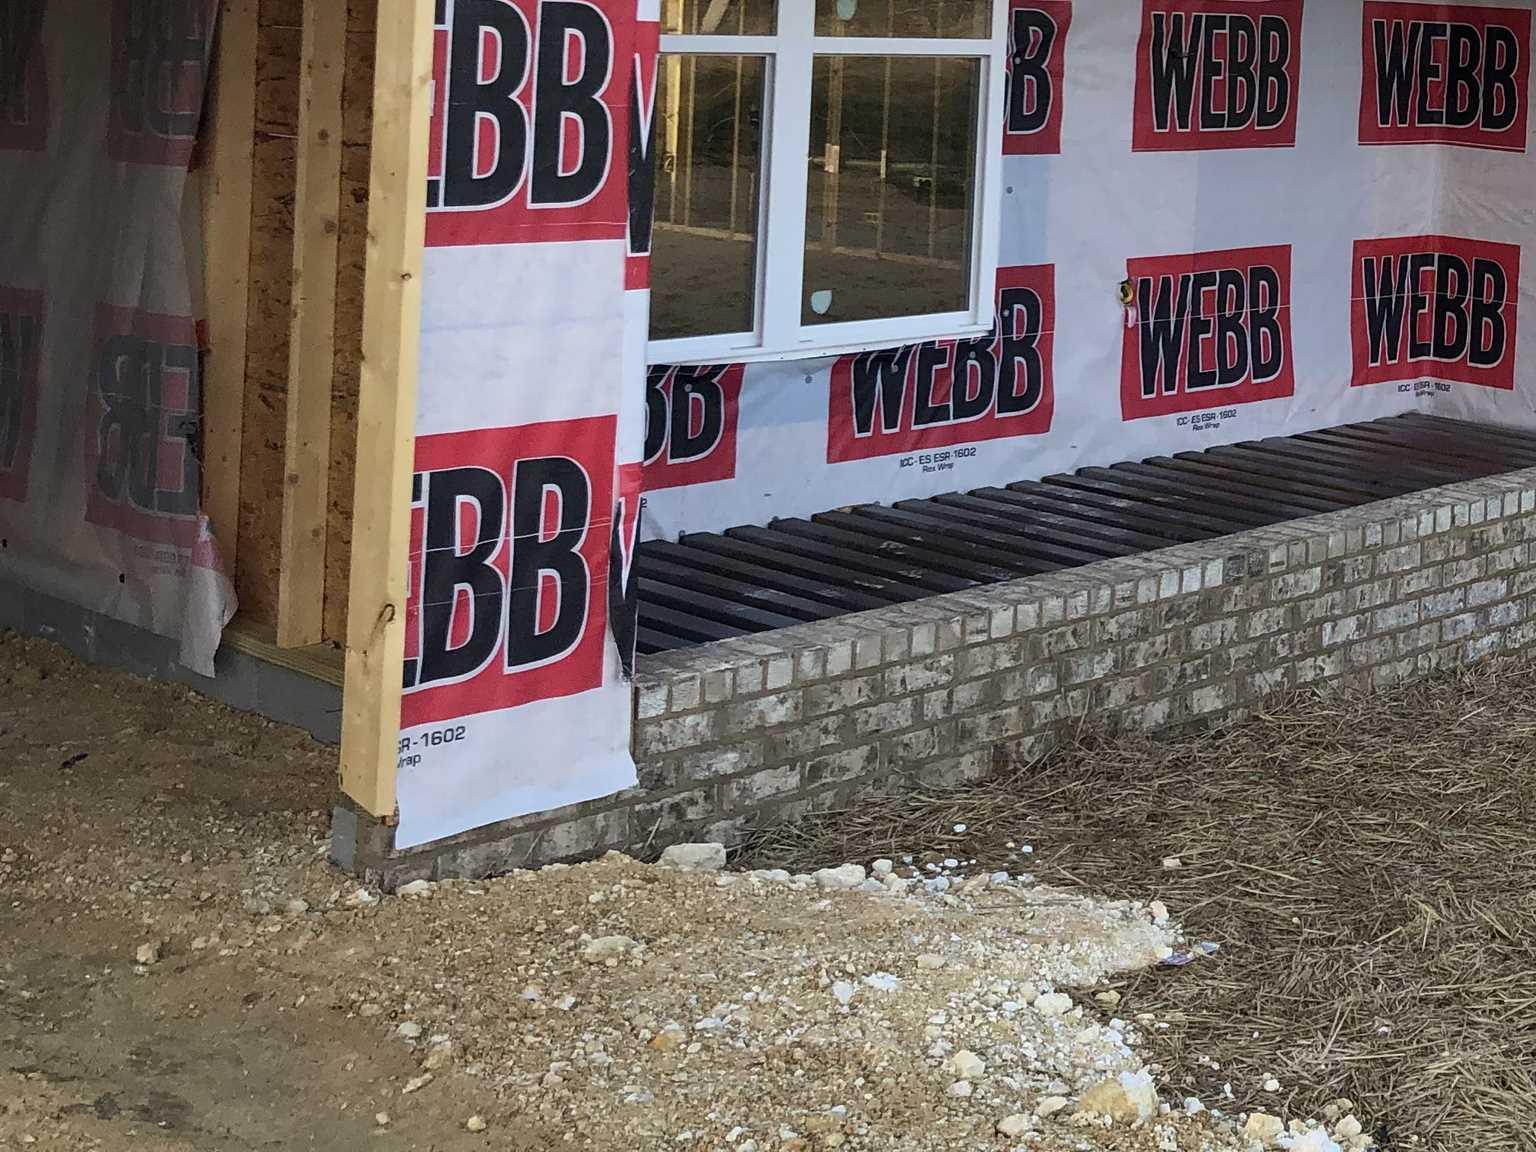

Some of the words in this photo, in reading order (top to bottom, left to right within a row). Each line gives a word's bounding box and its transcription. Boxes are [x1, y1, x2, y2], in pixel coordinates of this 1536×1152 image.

[1151, 10, 1291, 133] WEBB
[1371, 17, 1519, 132] WEBB
[1138, 264, 1284, 398] WEBB
[1362, 253, 1506, 368] WEBB
[401, 455, 592, 696] BB
